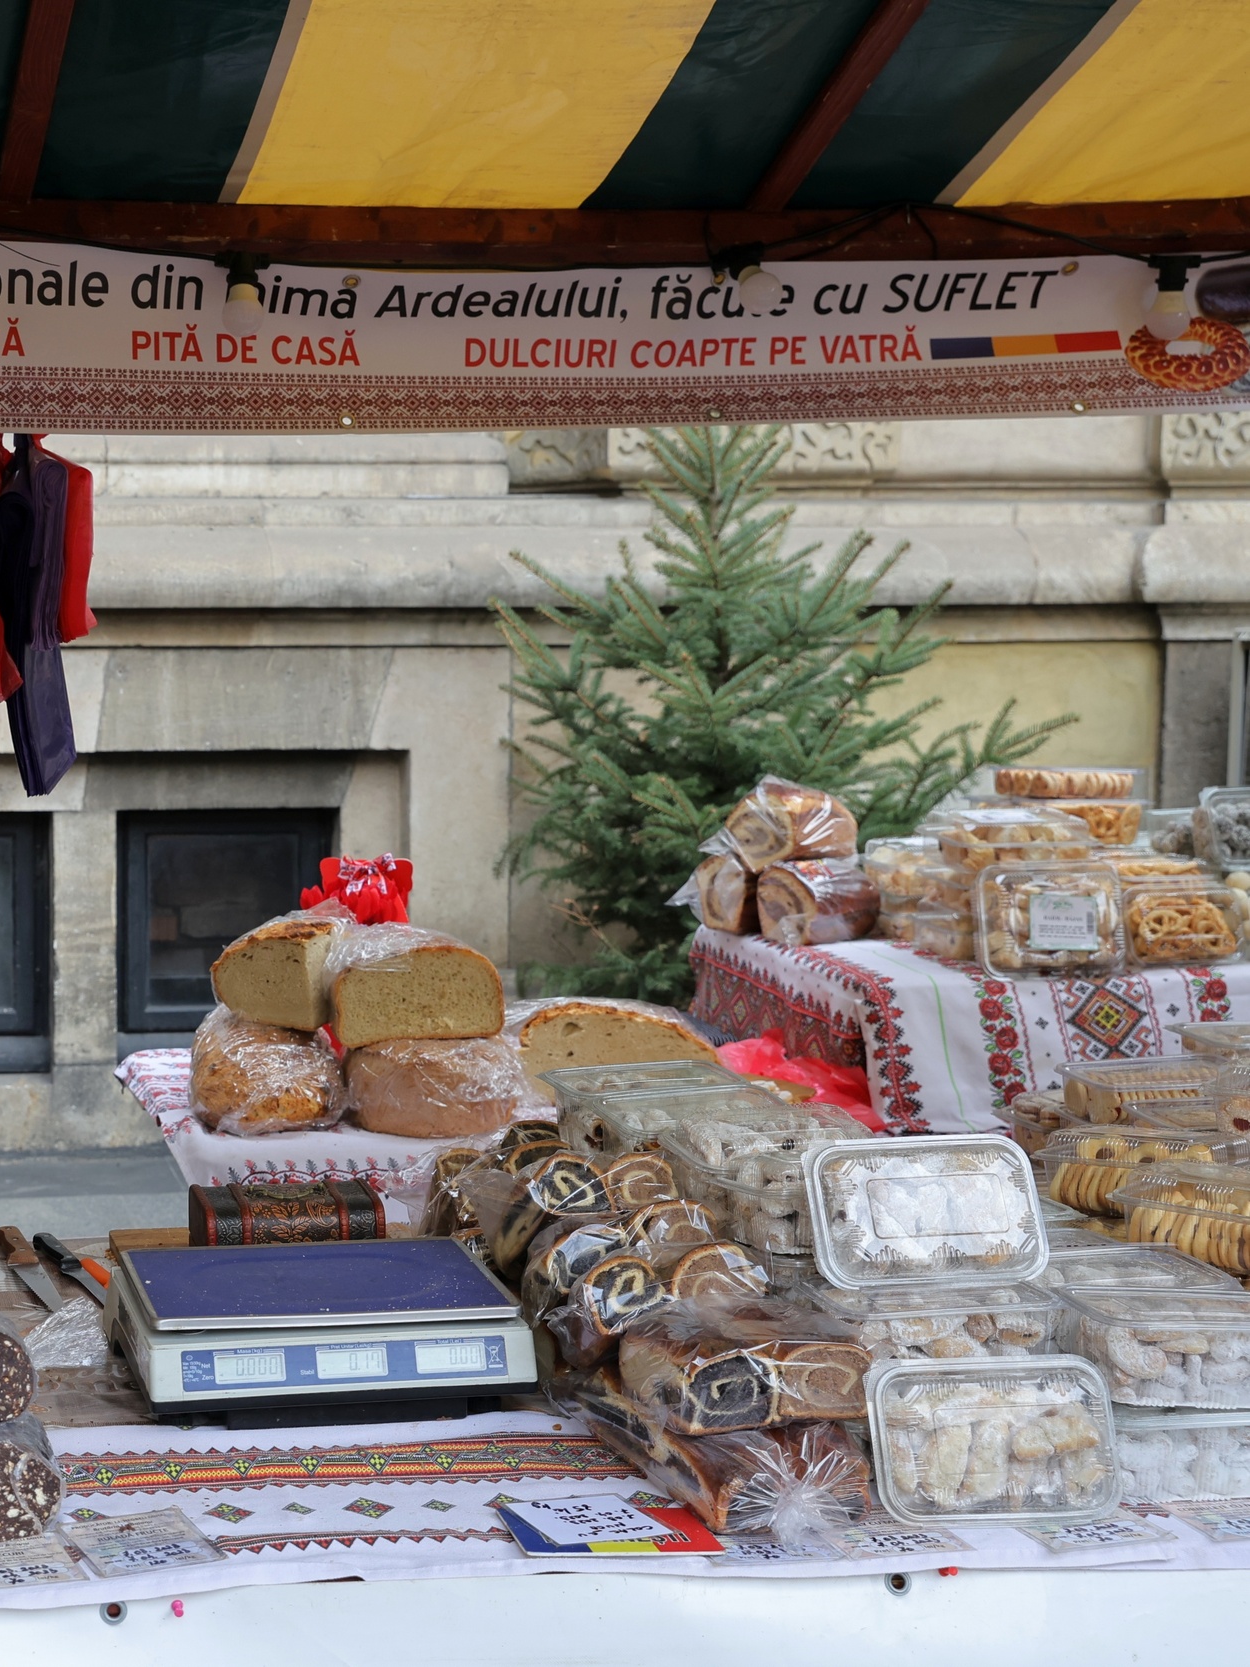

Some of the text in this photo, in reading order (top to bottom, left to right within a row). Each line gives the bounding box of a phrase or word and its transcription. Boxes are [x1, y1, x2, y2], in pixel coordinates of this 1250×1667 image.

[130, 263, 204, 311] din
[374, 276, 629, 323] Ardealului,
[650, 273, 795, 320] făcue
[813, 282, 868, 316] cu
[882, 270, 1059, 313] SUFLET
[131, 323, 361, 367] PITĂ DE CASĂ
[464, 324, 923, 369] DULCIURI COAPTE PE VATRĂ
